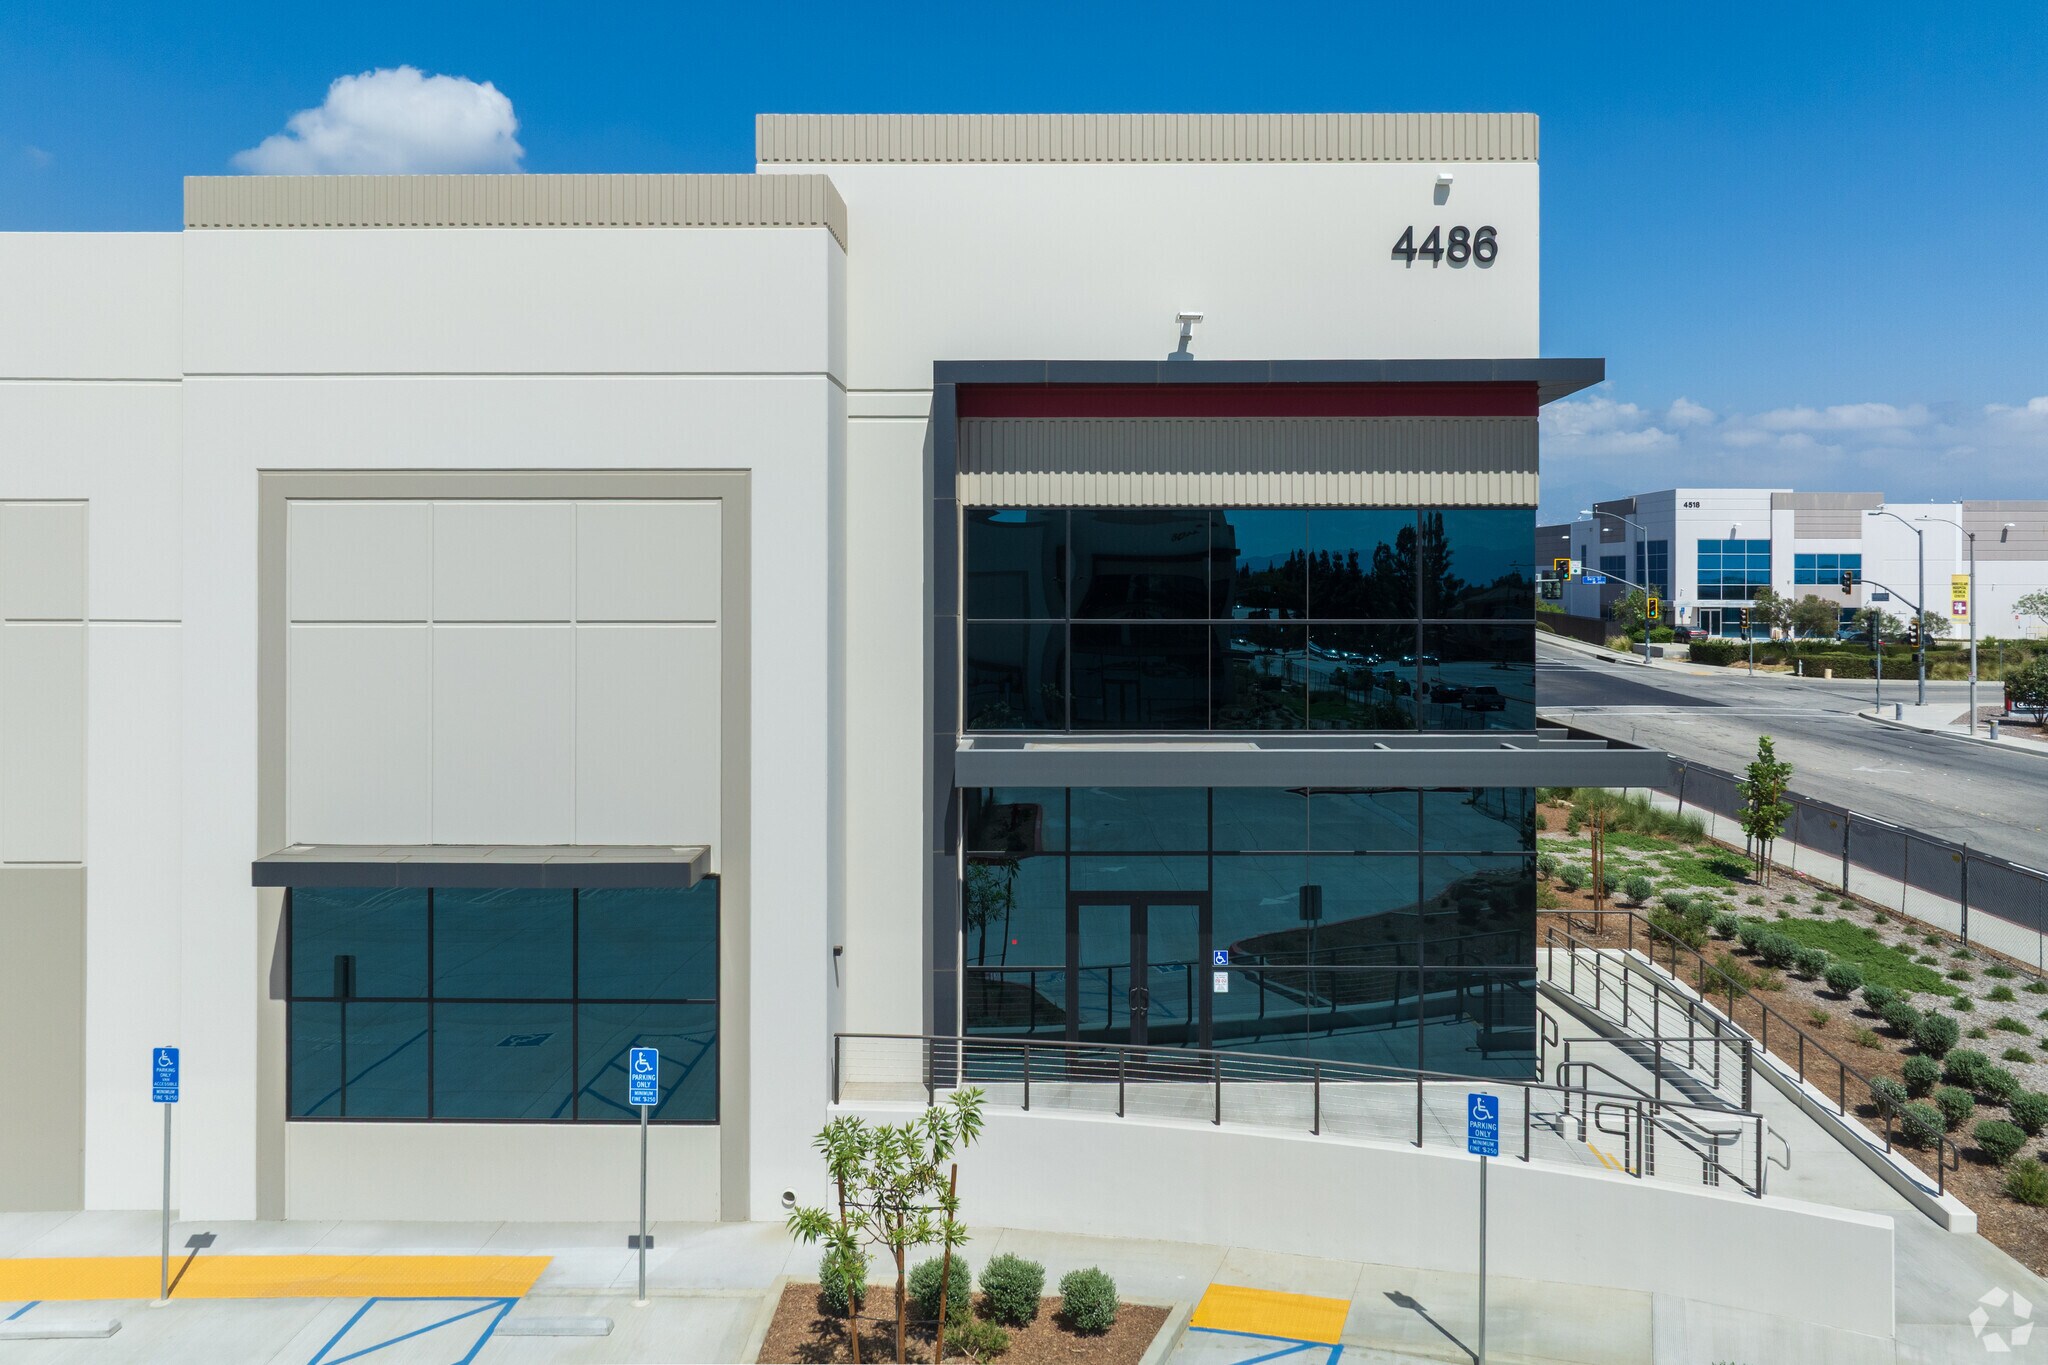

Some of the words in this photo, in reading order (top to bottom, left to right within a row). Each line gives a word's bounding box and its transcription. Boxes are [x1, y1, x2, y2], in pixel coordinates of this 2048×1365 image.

[1392, 225, 1498, 262] 4486
[1683, 501, 1701, 509] 4518
[1470, 1120, 1497, 1131] PARKING
[1474, 1129, 1492, 1138] ONLY
[1472, 1139, 1495, 1147] MINIMUM
[1481, 1146, 1498, 1155] $250
